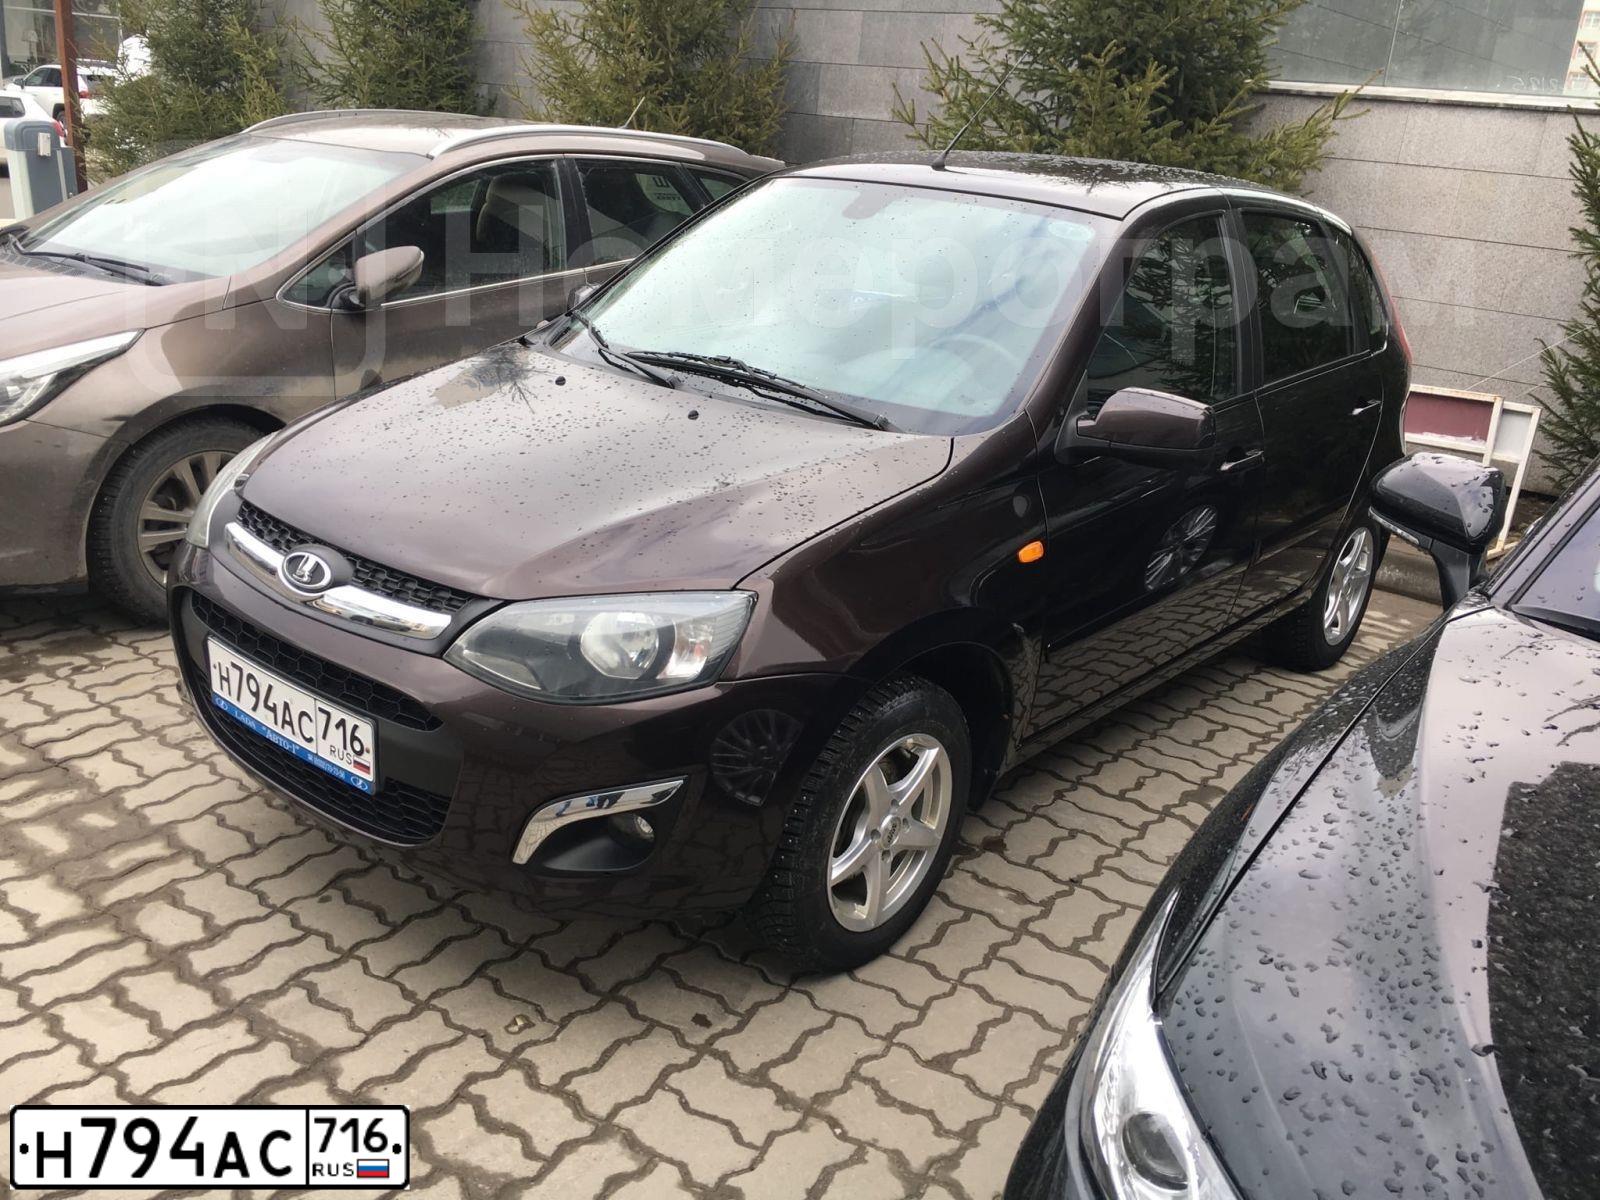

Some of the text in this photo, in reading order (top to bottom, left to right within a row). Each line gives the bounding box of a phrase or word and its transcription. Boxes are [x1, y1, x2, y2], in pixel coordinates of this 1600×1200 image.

[218, 661, 365, 756] Н794АС 716
[329, 745, 353, 765] RUS
